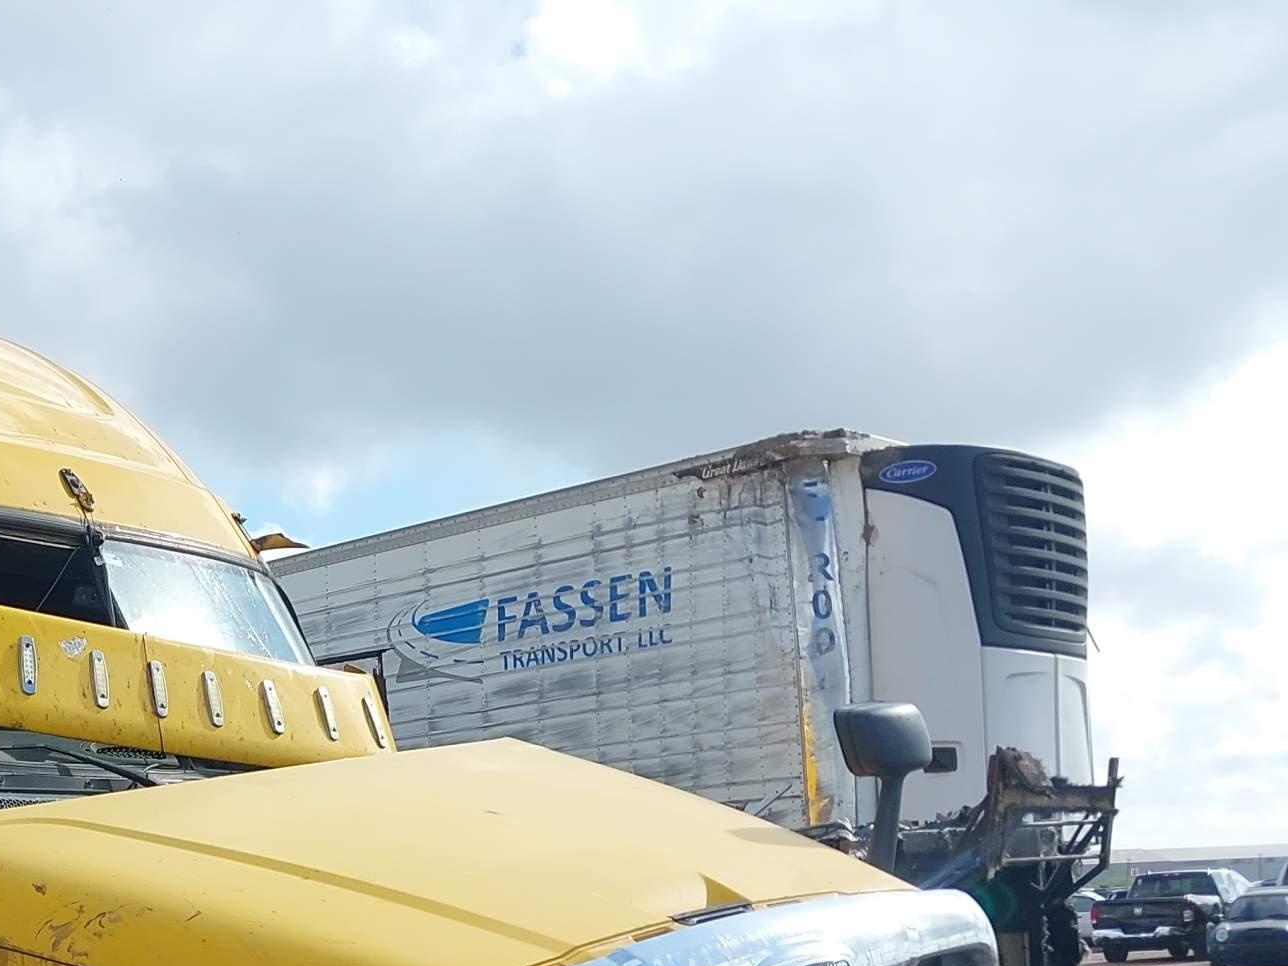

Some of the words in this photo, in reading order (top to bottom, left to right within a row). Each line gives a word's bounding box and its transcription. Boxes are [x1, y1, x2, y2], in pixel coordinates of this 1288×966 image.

[885, 464, 929, 481] Carrier
[497, 566, 672, 642] FASSEN
[638, 623, 673, 648] LLC
